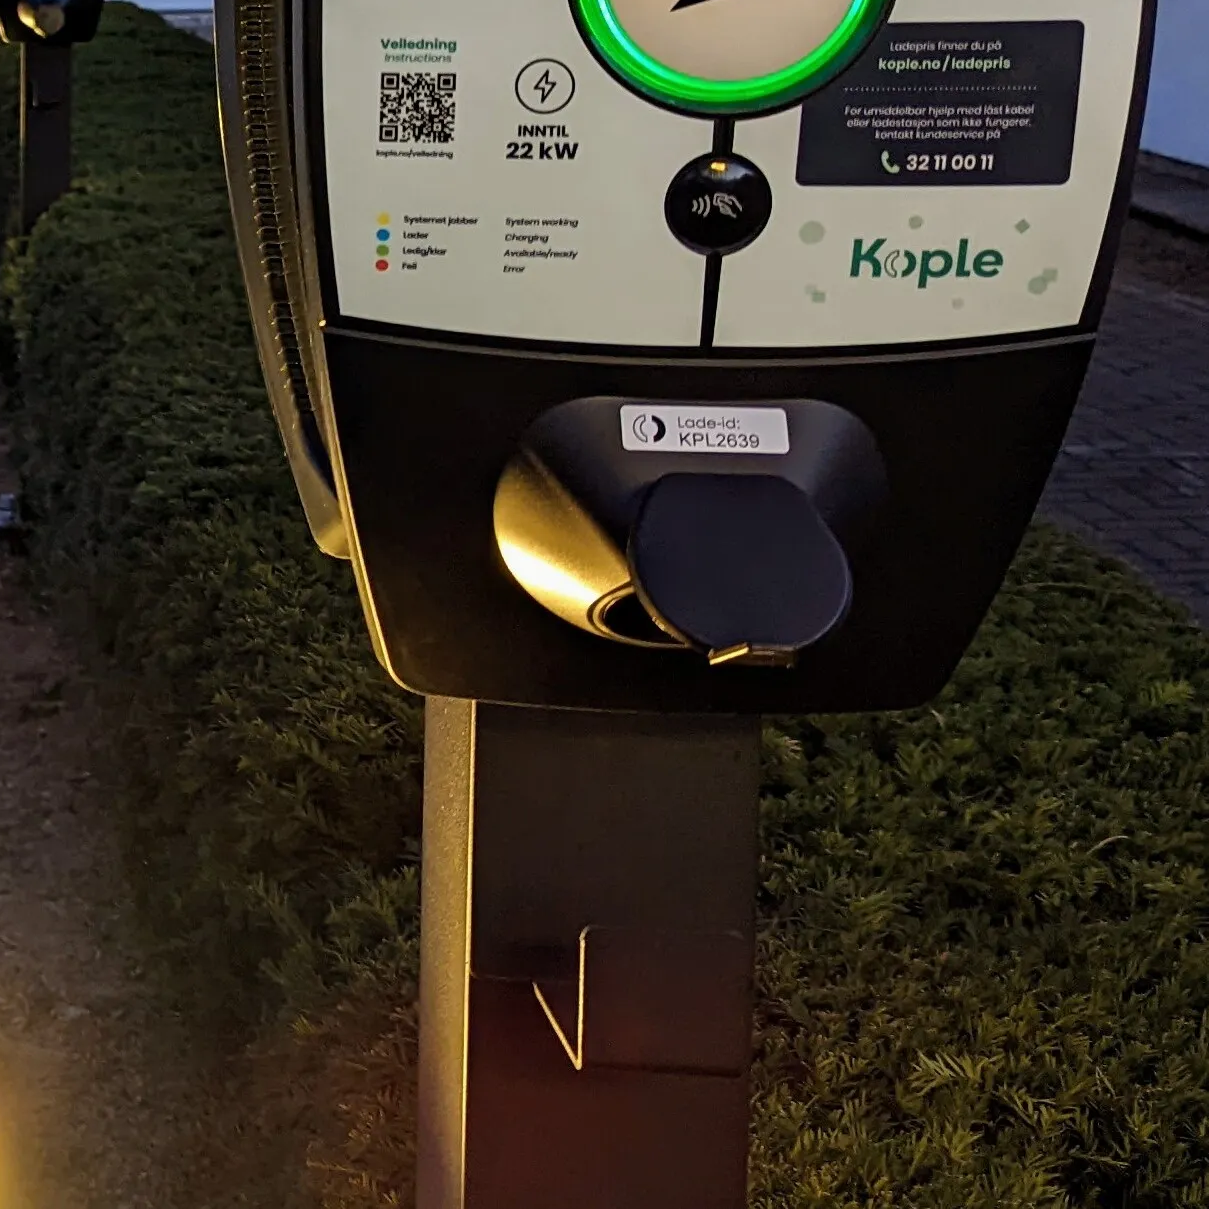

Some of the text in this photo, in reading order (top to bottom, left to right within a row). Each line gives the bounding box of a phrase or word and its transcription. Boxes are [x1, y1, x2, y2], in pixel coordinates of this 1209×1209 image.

[380, 38, 457, 53] Veiledning
[890, 40, 1002, 53] Ladepris finner du på
[844, 105, 862, 115] For
[928, 105, 954, 118] hjelp
[956, 105, 982, 115] med
[1005, 103, 1034, 114] kabel
[846, 118, 870, 128] eller
[872, 118, 934, 129] ladestasjon
[936, 119, 960, 127] som
[962, 118, 982, 127] ikke
[517, 125, 569, 138] INNTIL
[875, 129, 914, 139] kontakt
[986, 129, 1001, 141] på
[506, 142, 579, 160] 22 kW
[906, 154, 994, 171] 32 11 00 11
[849, 238, 1004, 289] Kople
[677, 416, 741, 430] Lade-id:
[679, 432, 760, 448] KPL2639
